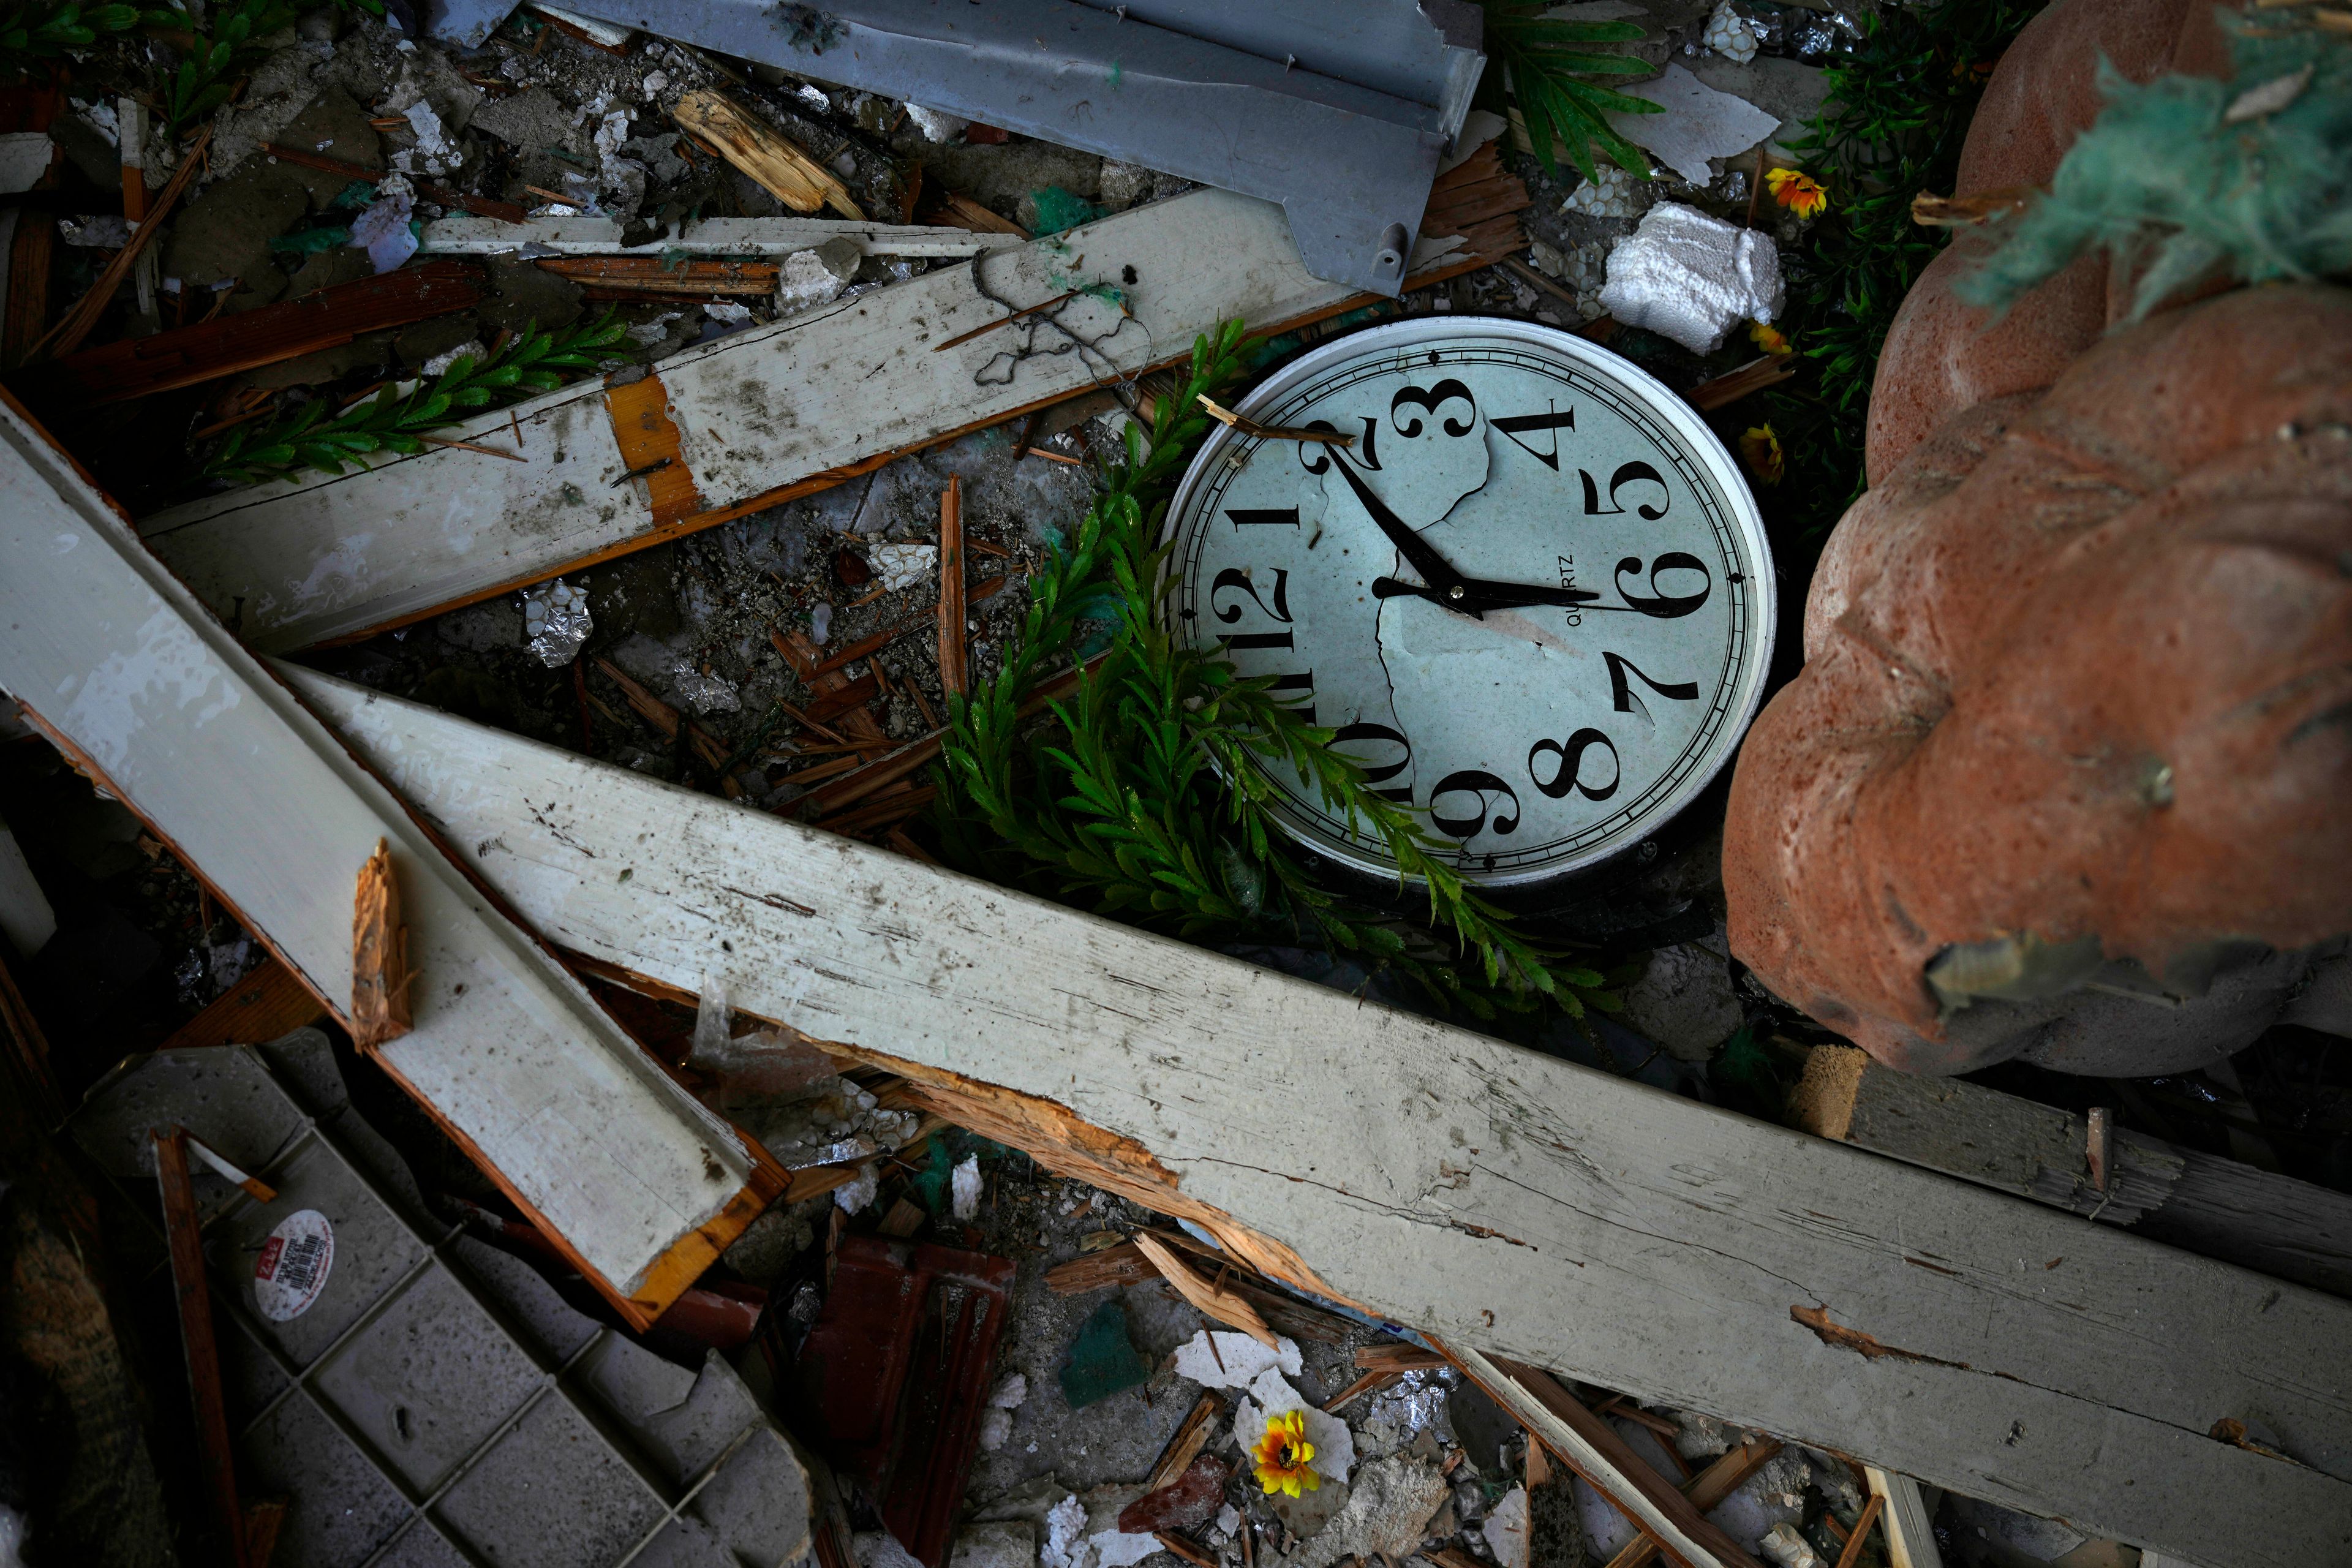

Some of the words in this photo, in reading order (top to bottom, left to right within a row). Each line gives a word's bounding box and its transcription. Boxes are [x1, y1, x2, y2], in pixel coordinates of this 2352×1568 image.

[1391, 379, 1476, 439] 3
[1490, 398, 1575, 472] 4
[1298, 417, 1383, 477] 2
[1224, 503, 1300, 533] 1
[1578, 461, 1670, 521] 5
[1210, 567, 1294, 658] 12
[1558, 554, 1582, 626] QURTZ
[1614, 552, 1711, 619] 6
[1602, 651, 1700, 714] 7
[1528, 728, 1620, 802] 8
[1430, 769, 1521, 838] 9
